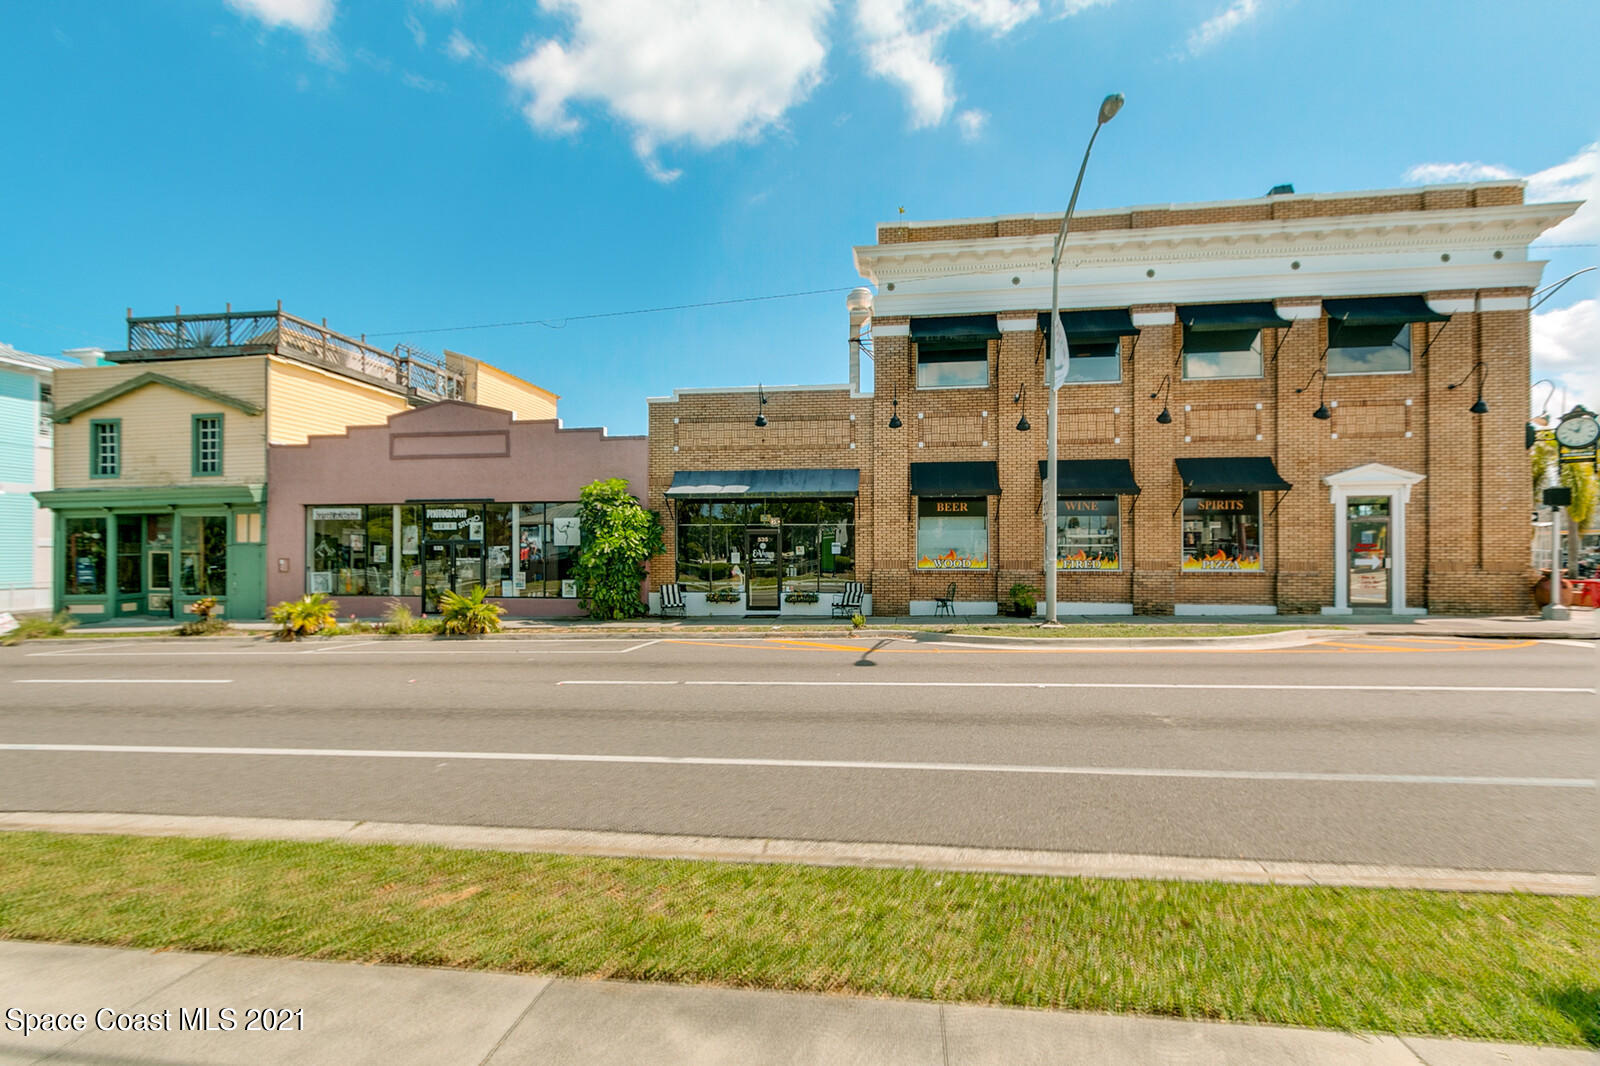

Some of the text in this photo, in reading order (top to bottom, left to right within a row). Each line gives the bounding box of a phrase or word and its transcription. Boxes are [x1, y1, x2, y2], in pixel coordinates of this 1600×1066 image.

[936, 502, 968, 512] BEER
[1065, 500, 1099, 511] WINE
[1197, 499, 1244, 511] SPIRITS
[426, 508, 467, 518] PHOTOGRAPHY
[458, 515, 480, 529] STUDIO
[933, 559, 972, 569] WOOD
[1062, 559, 1102, 569] FIRED
[1201, 559, 1241, 570] PIZZA
